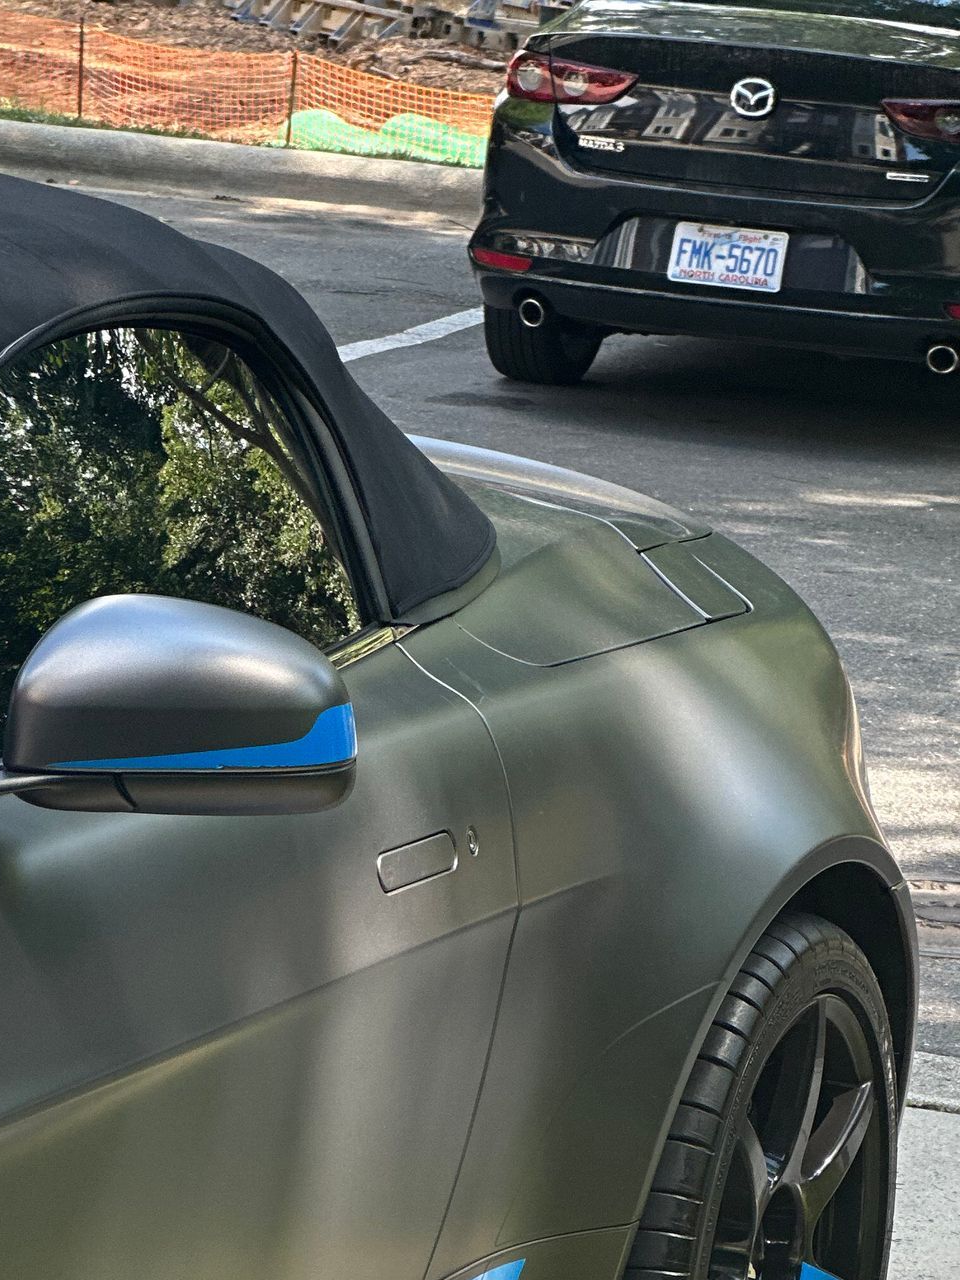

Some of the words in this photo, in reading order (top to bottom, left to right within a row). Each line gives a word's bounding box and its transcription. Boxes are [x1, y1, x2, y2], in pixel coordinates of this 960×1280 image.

[675, 237, 778, 277] FMK-5670
[679, 268, 715, 281] NORTH
[718, 272, 769, 287] CAROLINA
